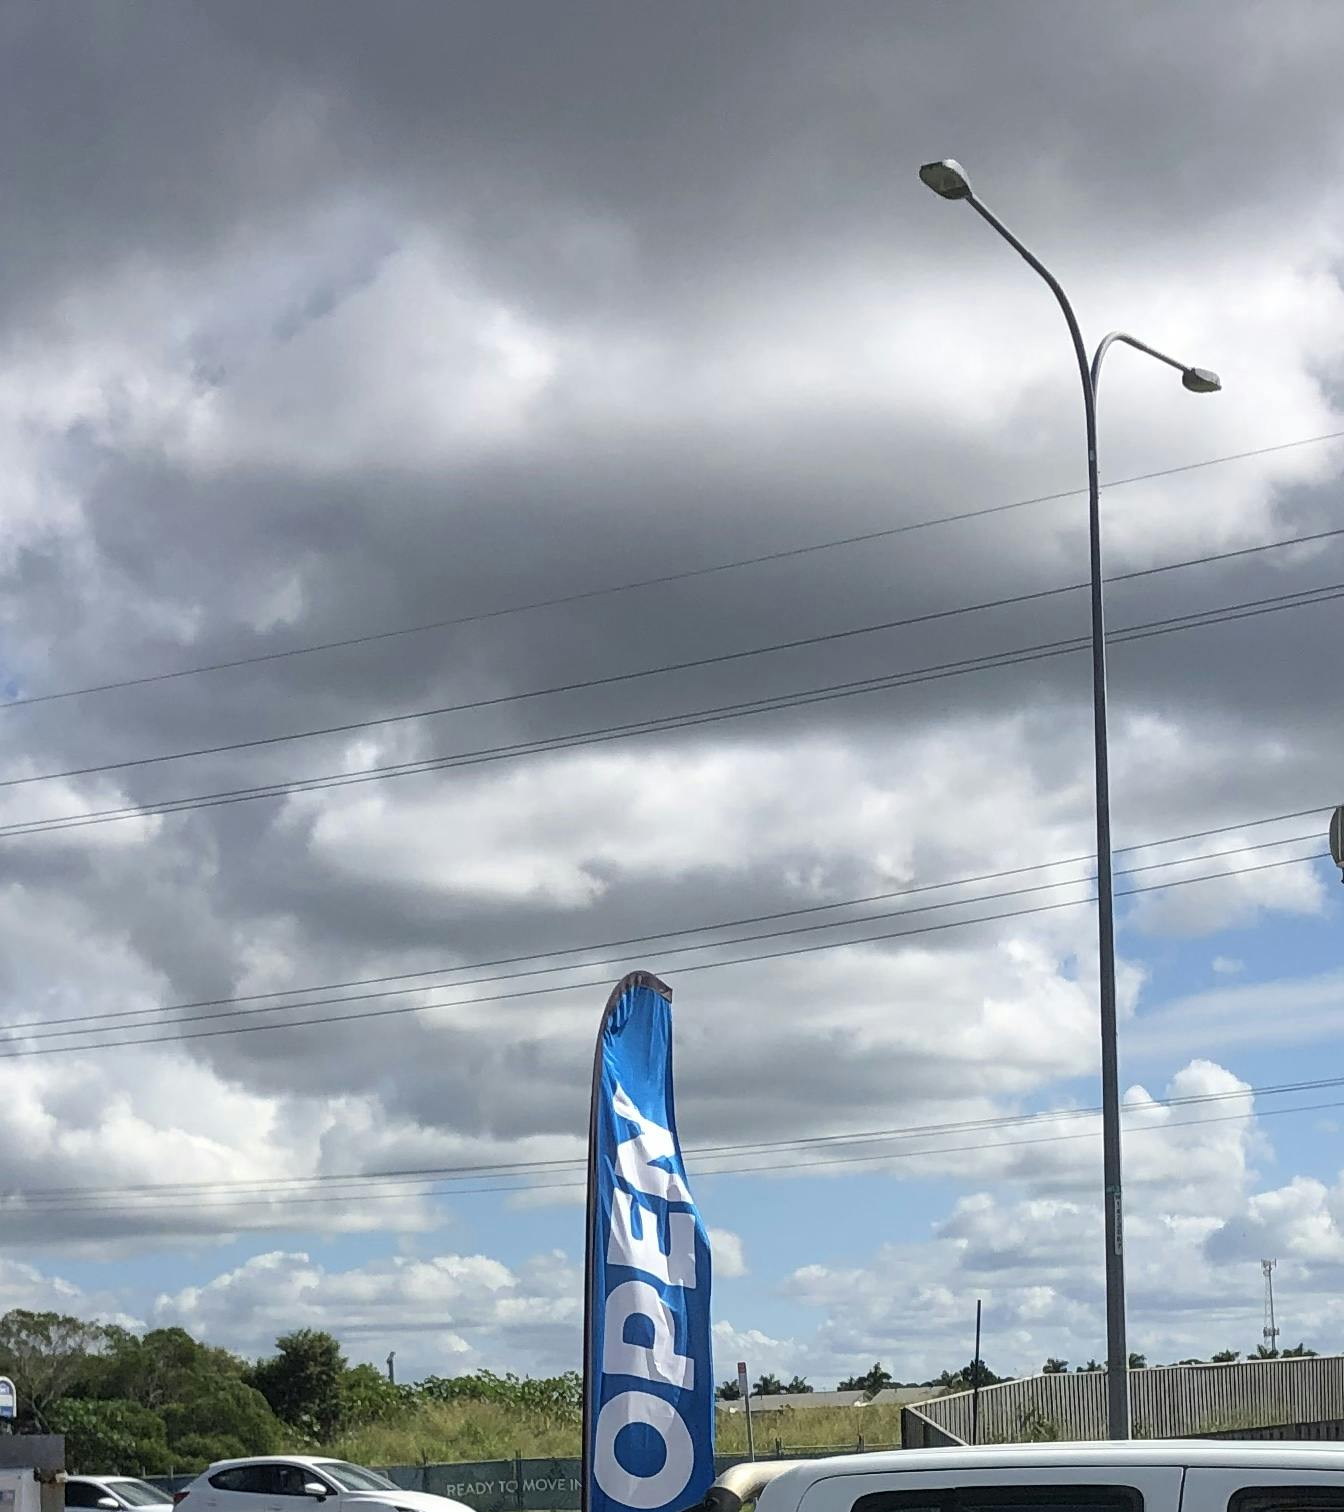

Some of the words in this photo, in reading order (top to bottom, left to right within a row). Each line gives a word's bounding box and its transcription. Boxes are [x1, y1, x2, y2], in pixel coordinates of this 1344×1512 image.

[593, 1087, 696, 1510] OPEN
[446, 1480, 495, 1497] READY
[498, 1480, 518, 1493] TO
[522, 1478, 566, 1493] MOVE
